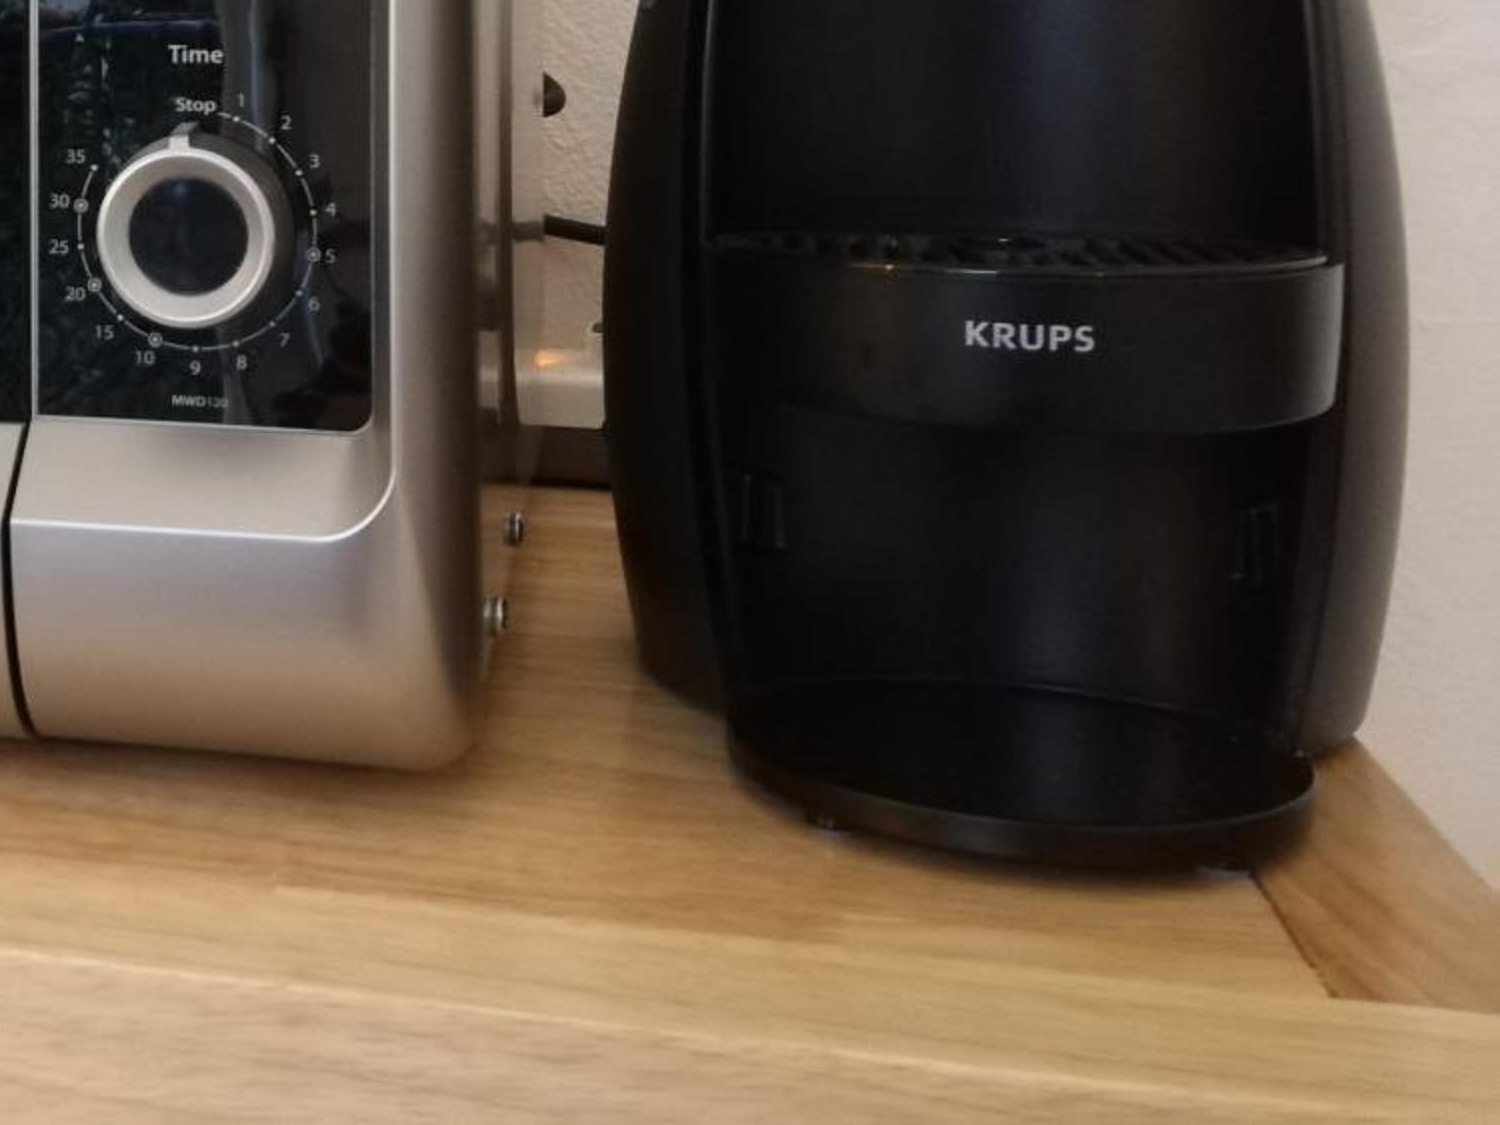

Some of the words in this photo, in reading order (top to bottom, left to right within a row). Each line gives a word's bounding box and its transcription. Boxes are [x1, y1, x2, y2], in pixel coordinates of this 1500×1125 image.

[168, 44, 225, 64] Time
[175, 97, 217, 115] Stop
[238, 93, 244, 107] 1
[281, 116, 292, 130] 2
[67, 149, 85, 163] 35
[310, 154, 321, 169] 3
[50, 194, 70, 209] 30
[325, 203, 337, 217] 4
[49, 240, 69, 255] 25
[326, 249, 336, 264] 5
[65, 286, 86, 302] 20
[308, 297, 320, 311] 6
[96, 325, 114, 340] 15
[280, 332, 290, 347] 7
[964, 320, 1095, 352] KRUPS
[137, 350, 155, 365] 10
[237, 355, 247, 370] 8
[190, 361, 201, 376] 9
